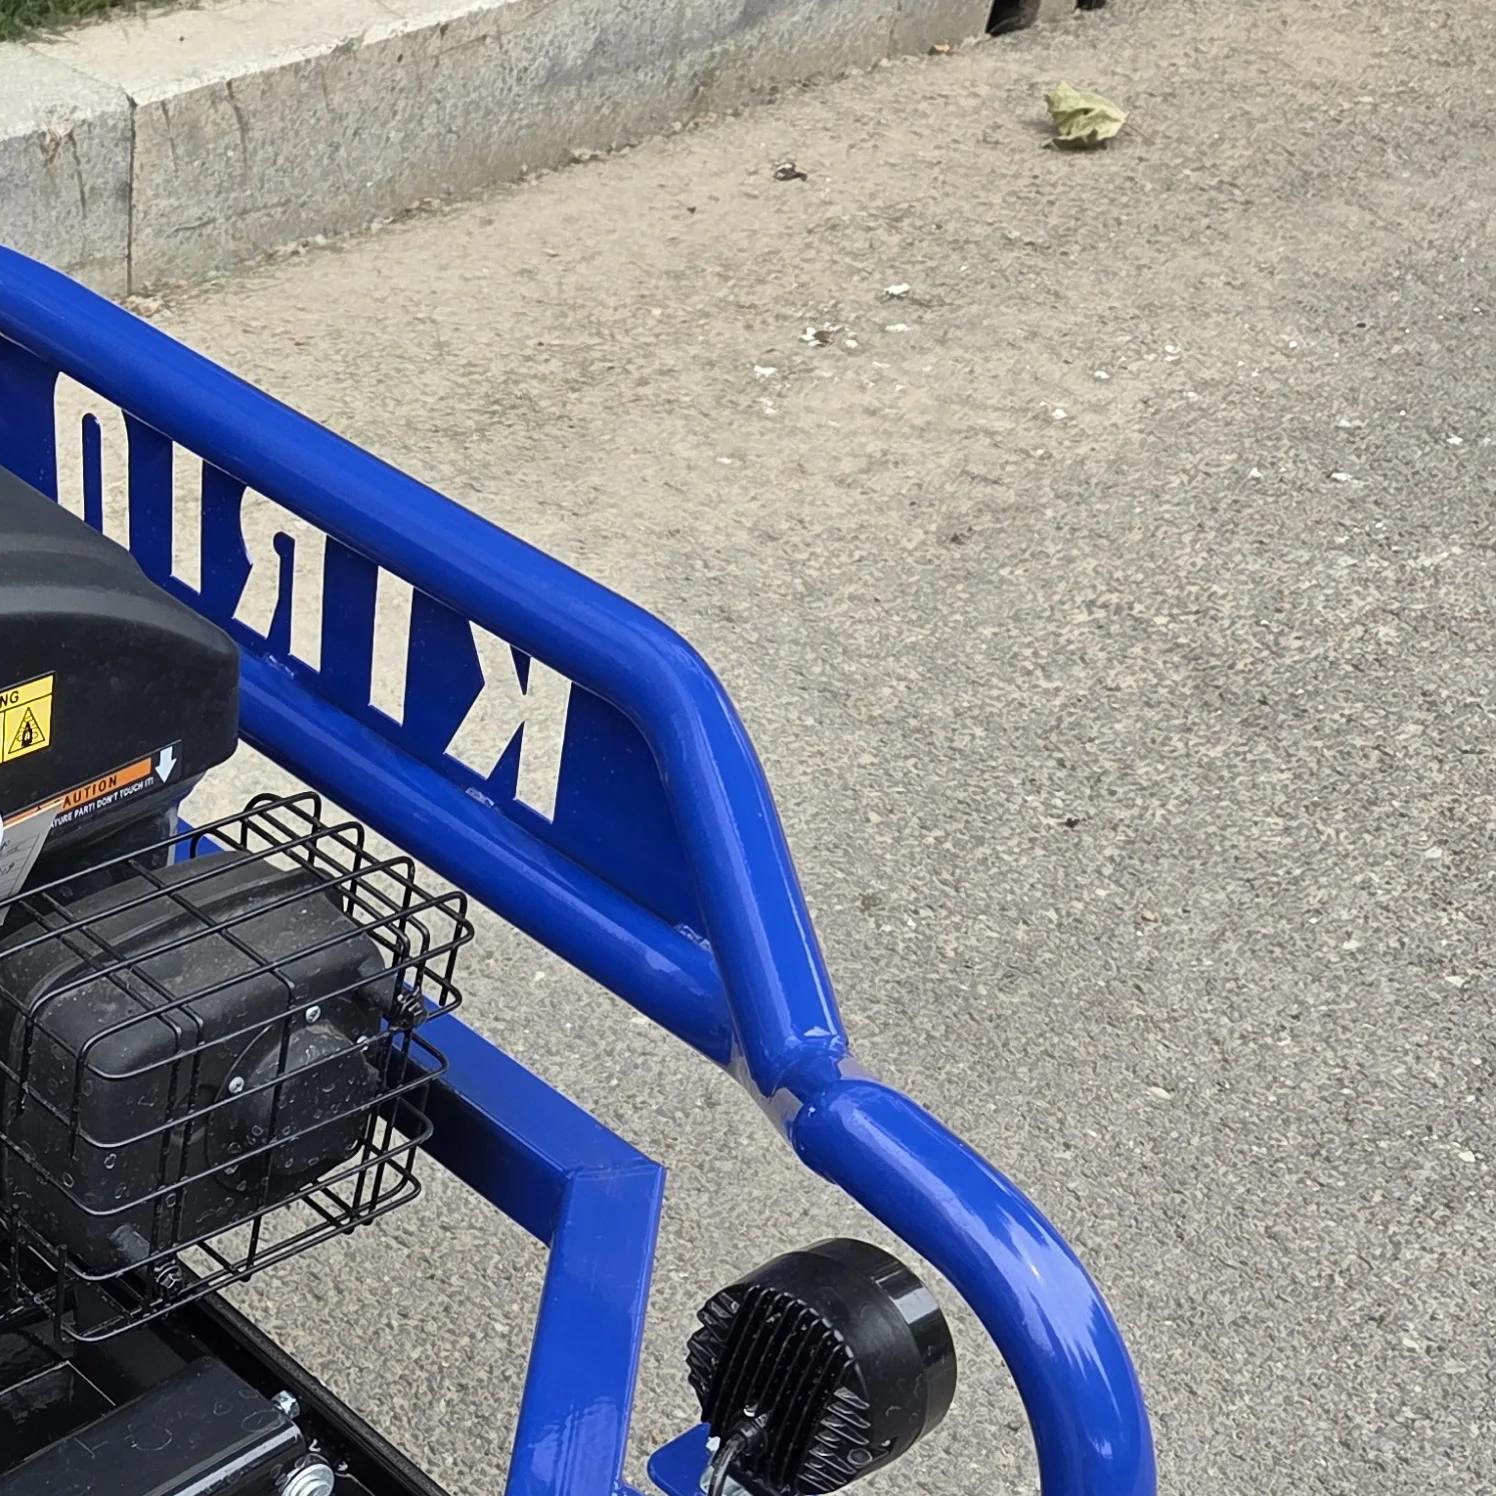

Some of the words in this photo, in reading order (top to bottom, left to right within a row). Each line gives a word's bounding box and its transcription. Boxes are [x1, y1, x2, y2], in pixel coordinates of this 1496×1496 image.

[54, 775, 118, 808] AUTION
[97, 792, 118, 808] DON'T
[120, 783, 144, 798] TOUCH
